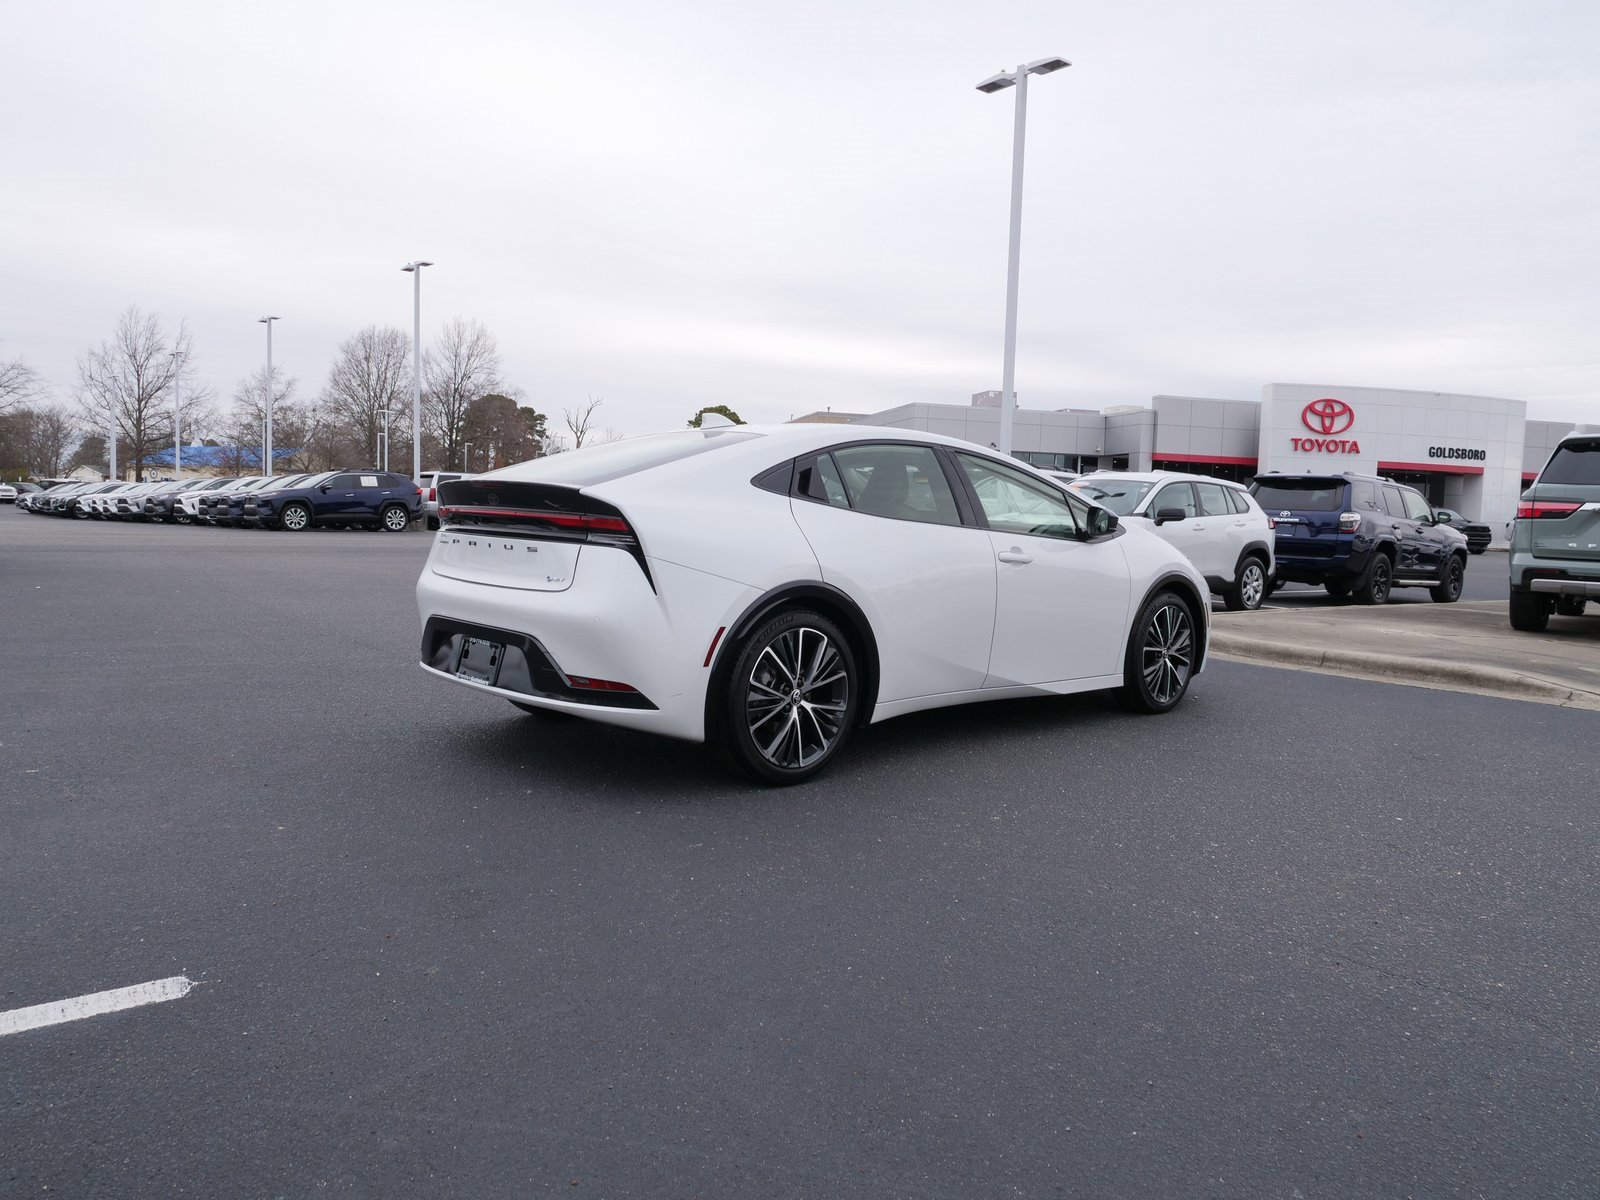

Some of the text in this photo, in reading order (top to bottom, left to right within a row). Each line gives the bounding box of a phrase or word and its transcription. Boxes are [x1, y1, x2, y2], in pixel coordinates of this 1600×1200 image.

[1291, 437, 1360, 455] TOYOTA
[1428, 446, 1486, 461] GOLDSBORO
[452, 538, 538, 552] PRIUS
[759, 614, 794, 643] MICHELIN
